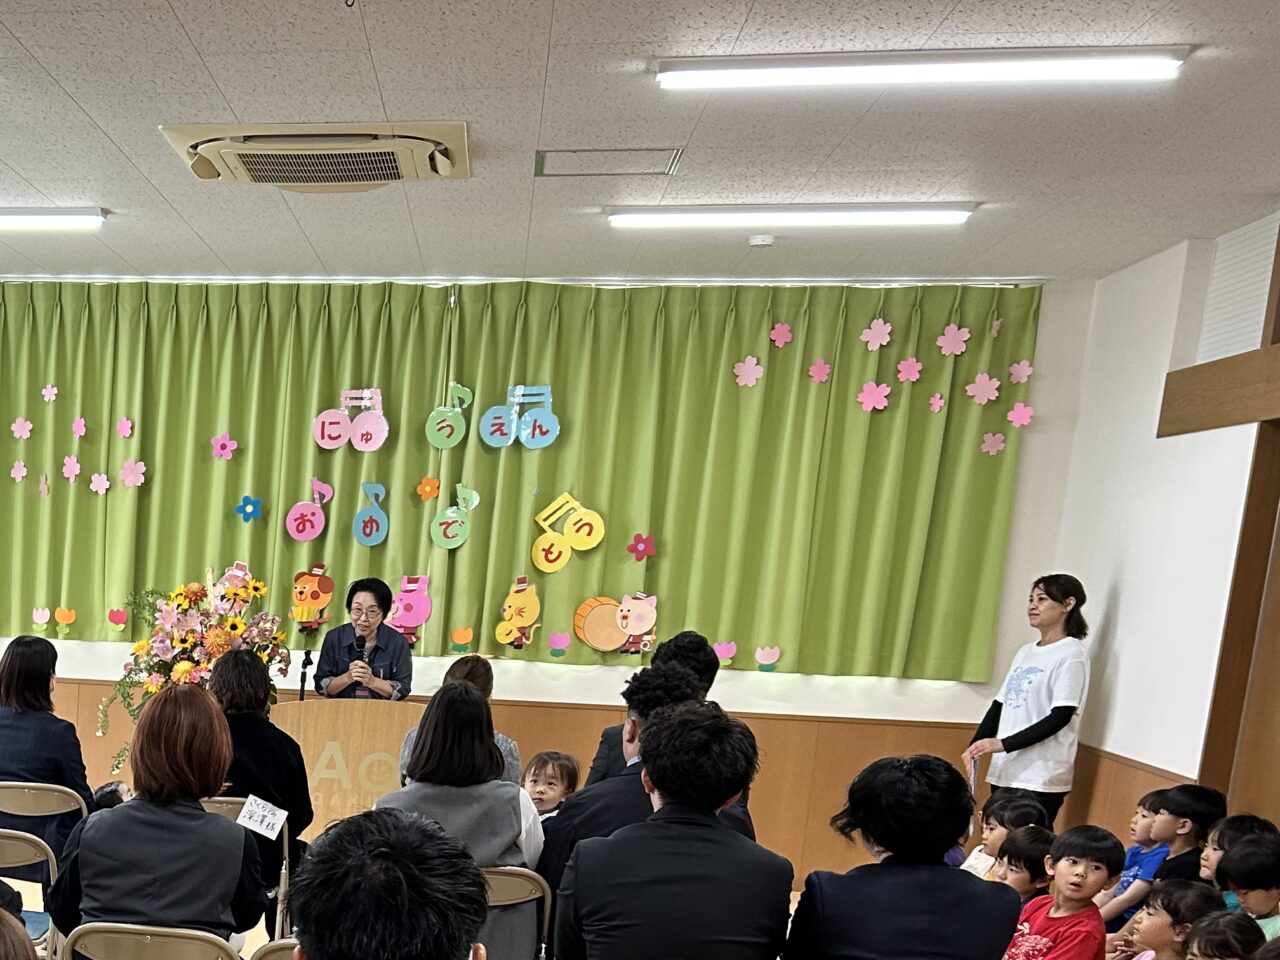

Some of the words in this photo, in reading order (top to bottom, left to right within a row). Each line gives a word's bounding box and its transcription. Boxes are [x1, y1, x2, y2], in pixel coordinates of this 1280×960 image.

[321, 414, 550, 444] にゅうえん
[293, 511, 594, 564] おめでとう
